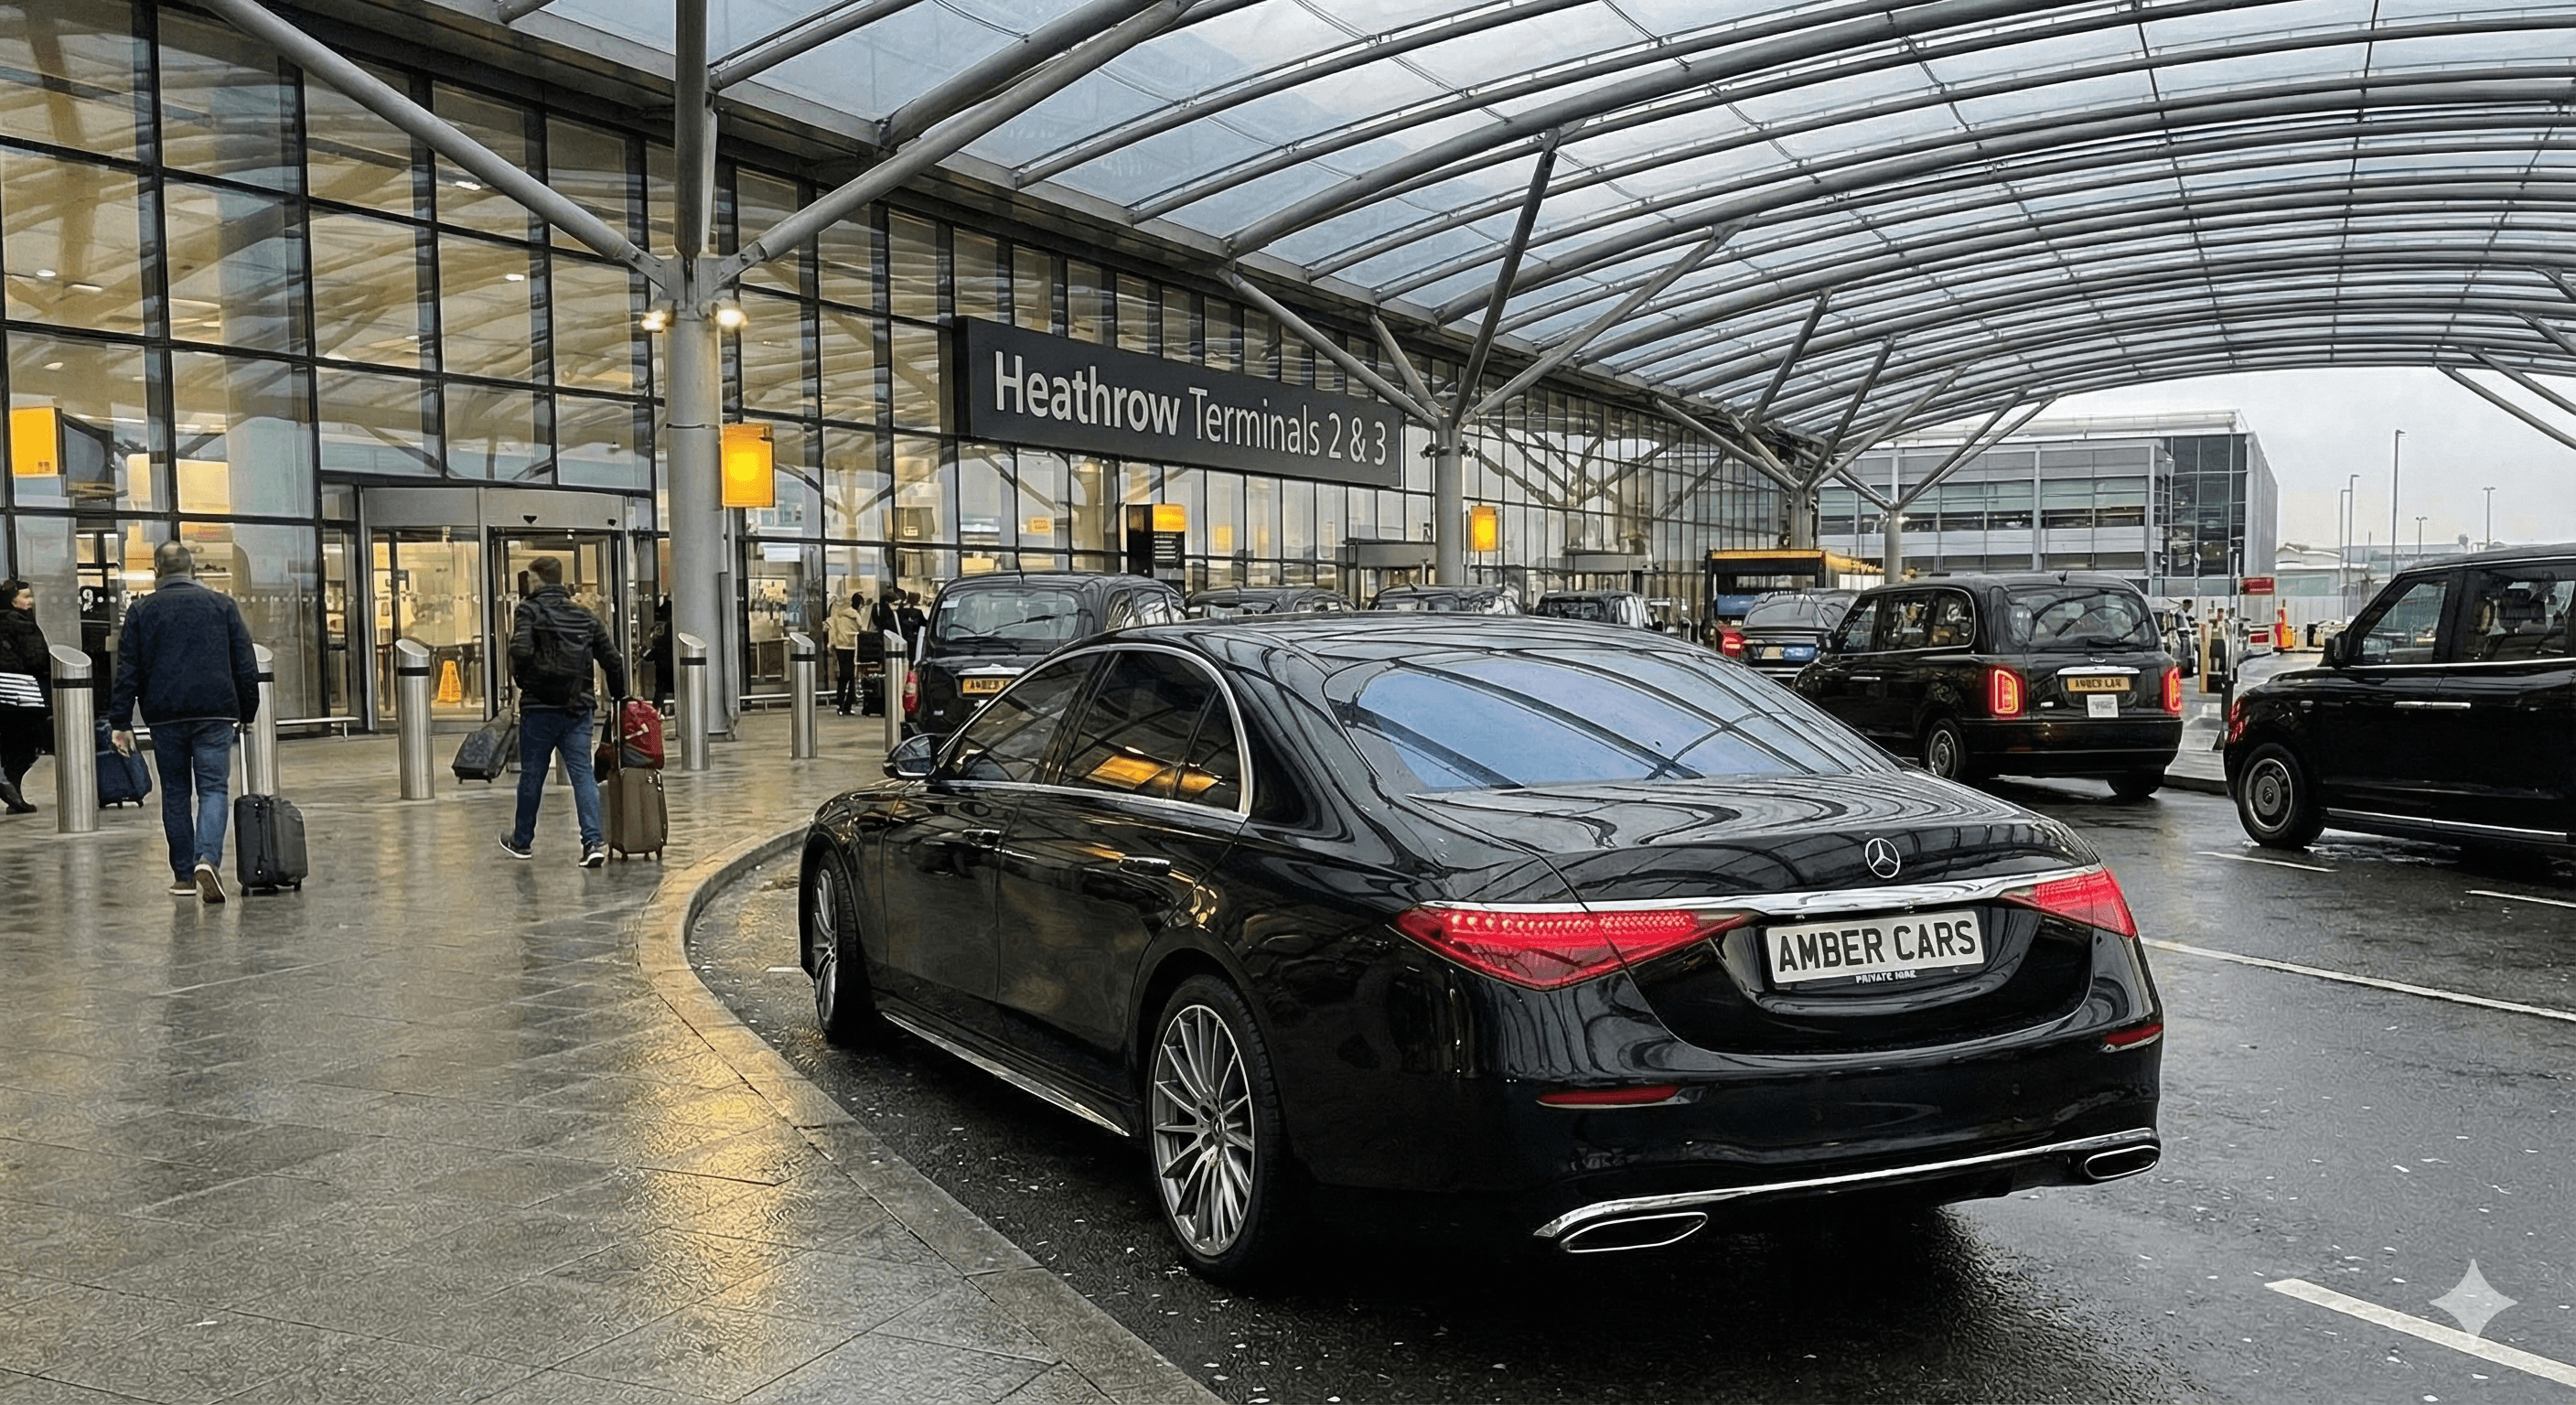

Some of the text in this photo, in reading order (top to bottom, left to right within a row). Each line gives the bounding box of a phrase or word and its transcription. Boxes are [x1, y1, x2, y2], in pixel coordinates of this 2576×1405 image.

[993, 349, 1387, 467] Heathrow Terminals 2 & 3
[1778, 920, 1976, 972] AMBER CARS
[1855, 971, 1893, 984] PRIVATE
